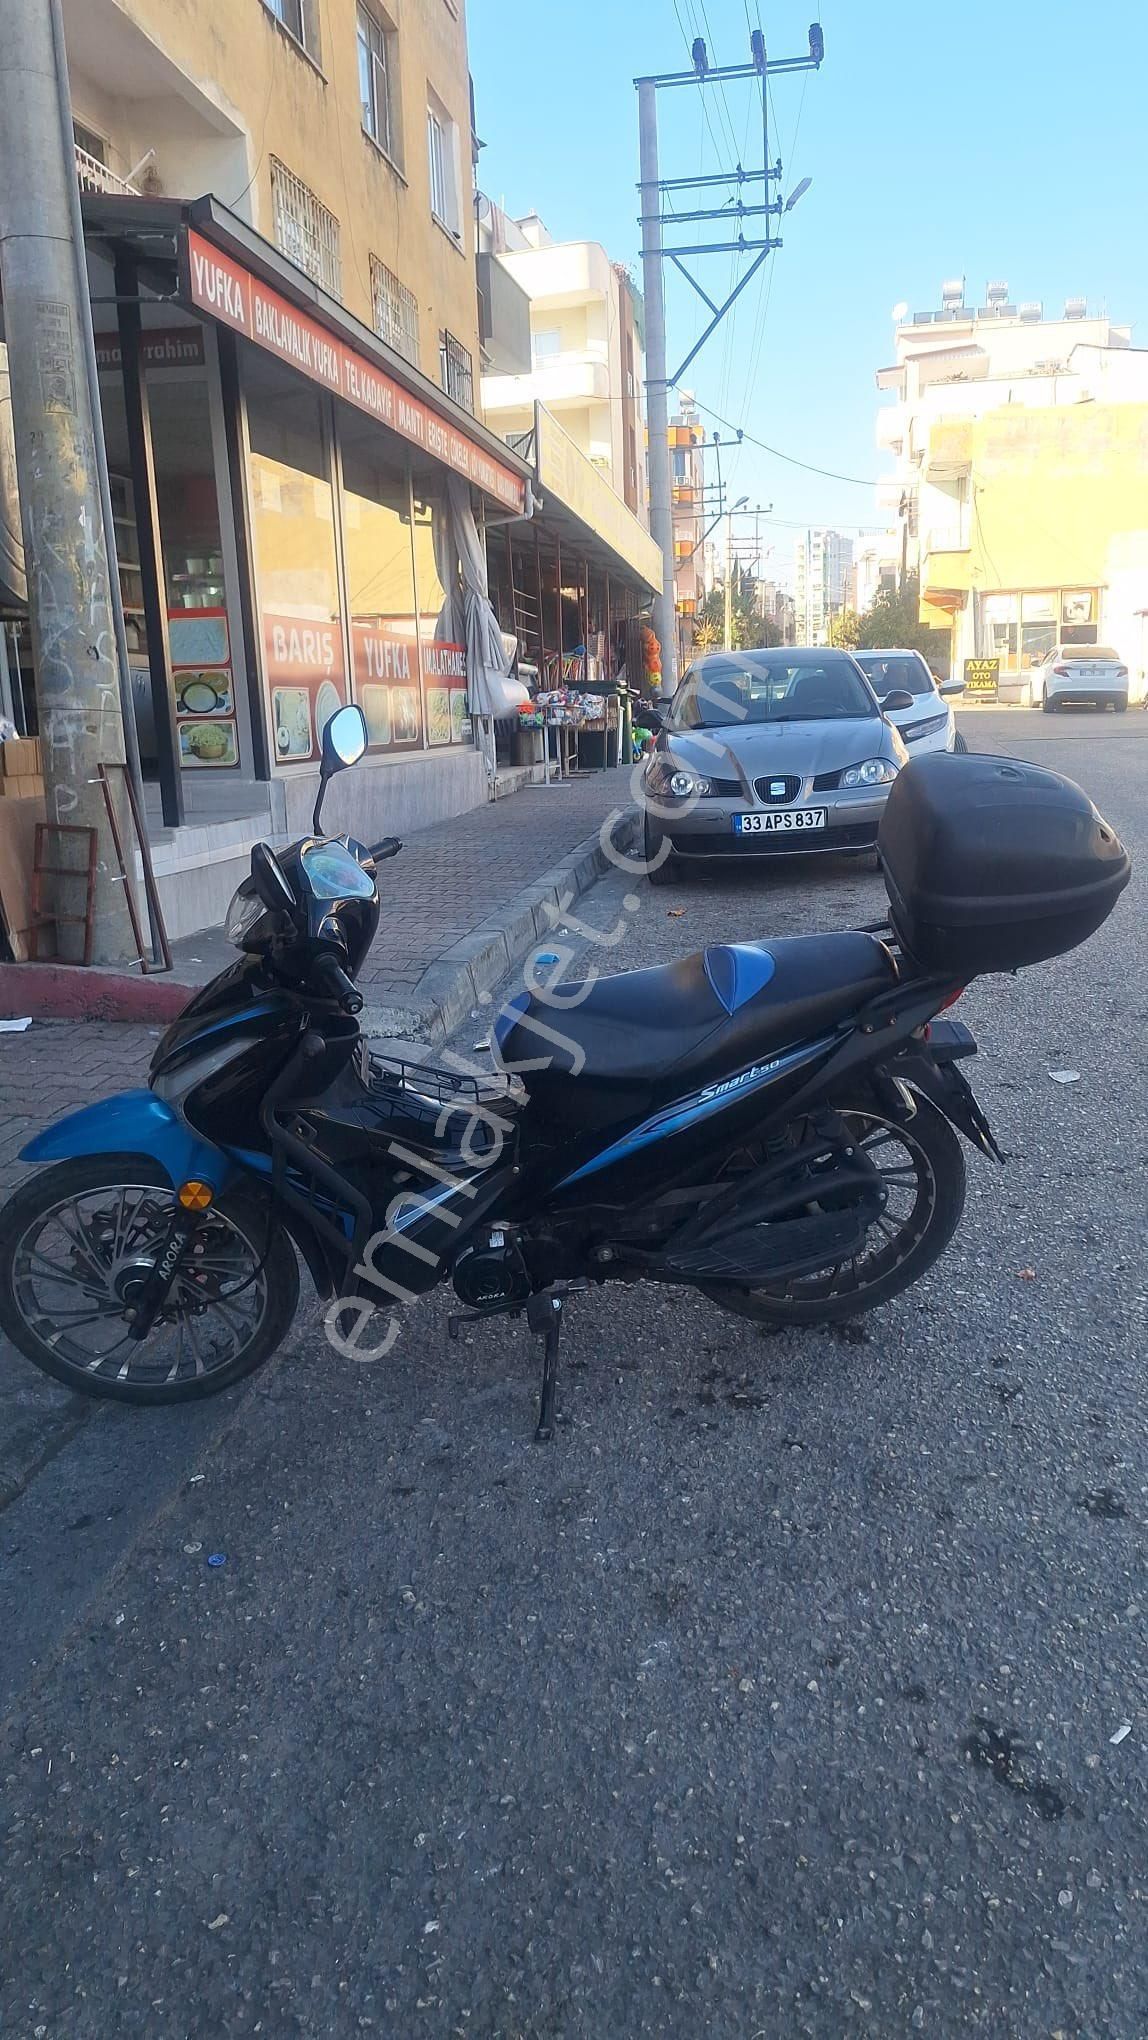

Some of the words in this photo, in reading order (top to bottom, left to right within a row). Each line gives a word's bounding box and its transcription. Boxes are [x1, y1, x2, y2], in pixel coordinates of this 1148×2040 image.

[192, 250, 245, 323] YUFKA
[255, 295, 312, 367] BAKLAVALIK
[312, 335, 339, 385] YUFKA
[345, 359, 361, 399] TEL
[361, 370, 392, 420] KADAYIF
[398, 399, 424, 441] MANTI
[272, 624, 335, 676] BARIŞ
[363, 636, 411, 680] YUFKA
[966, 660, 998, 671] AYAZ
[966, 680, 997, 689] YIKAMA
[972, 672, 991, 680] OTO
[743, 816, 761, 831] 33
[765, 813, 792, 830] APS
[795, 811, 823, 828] 837
[158, 1232, 187, 1281] ARORA
